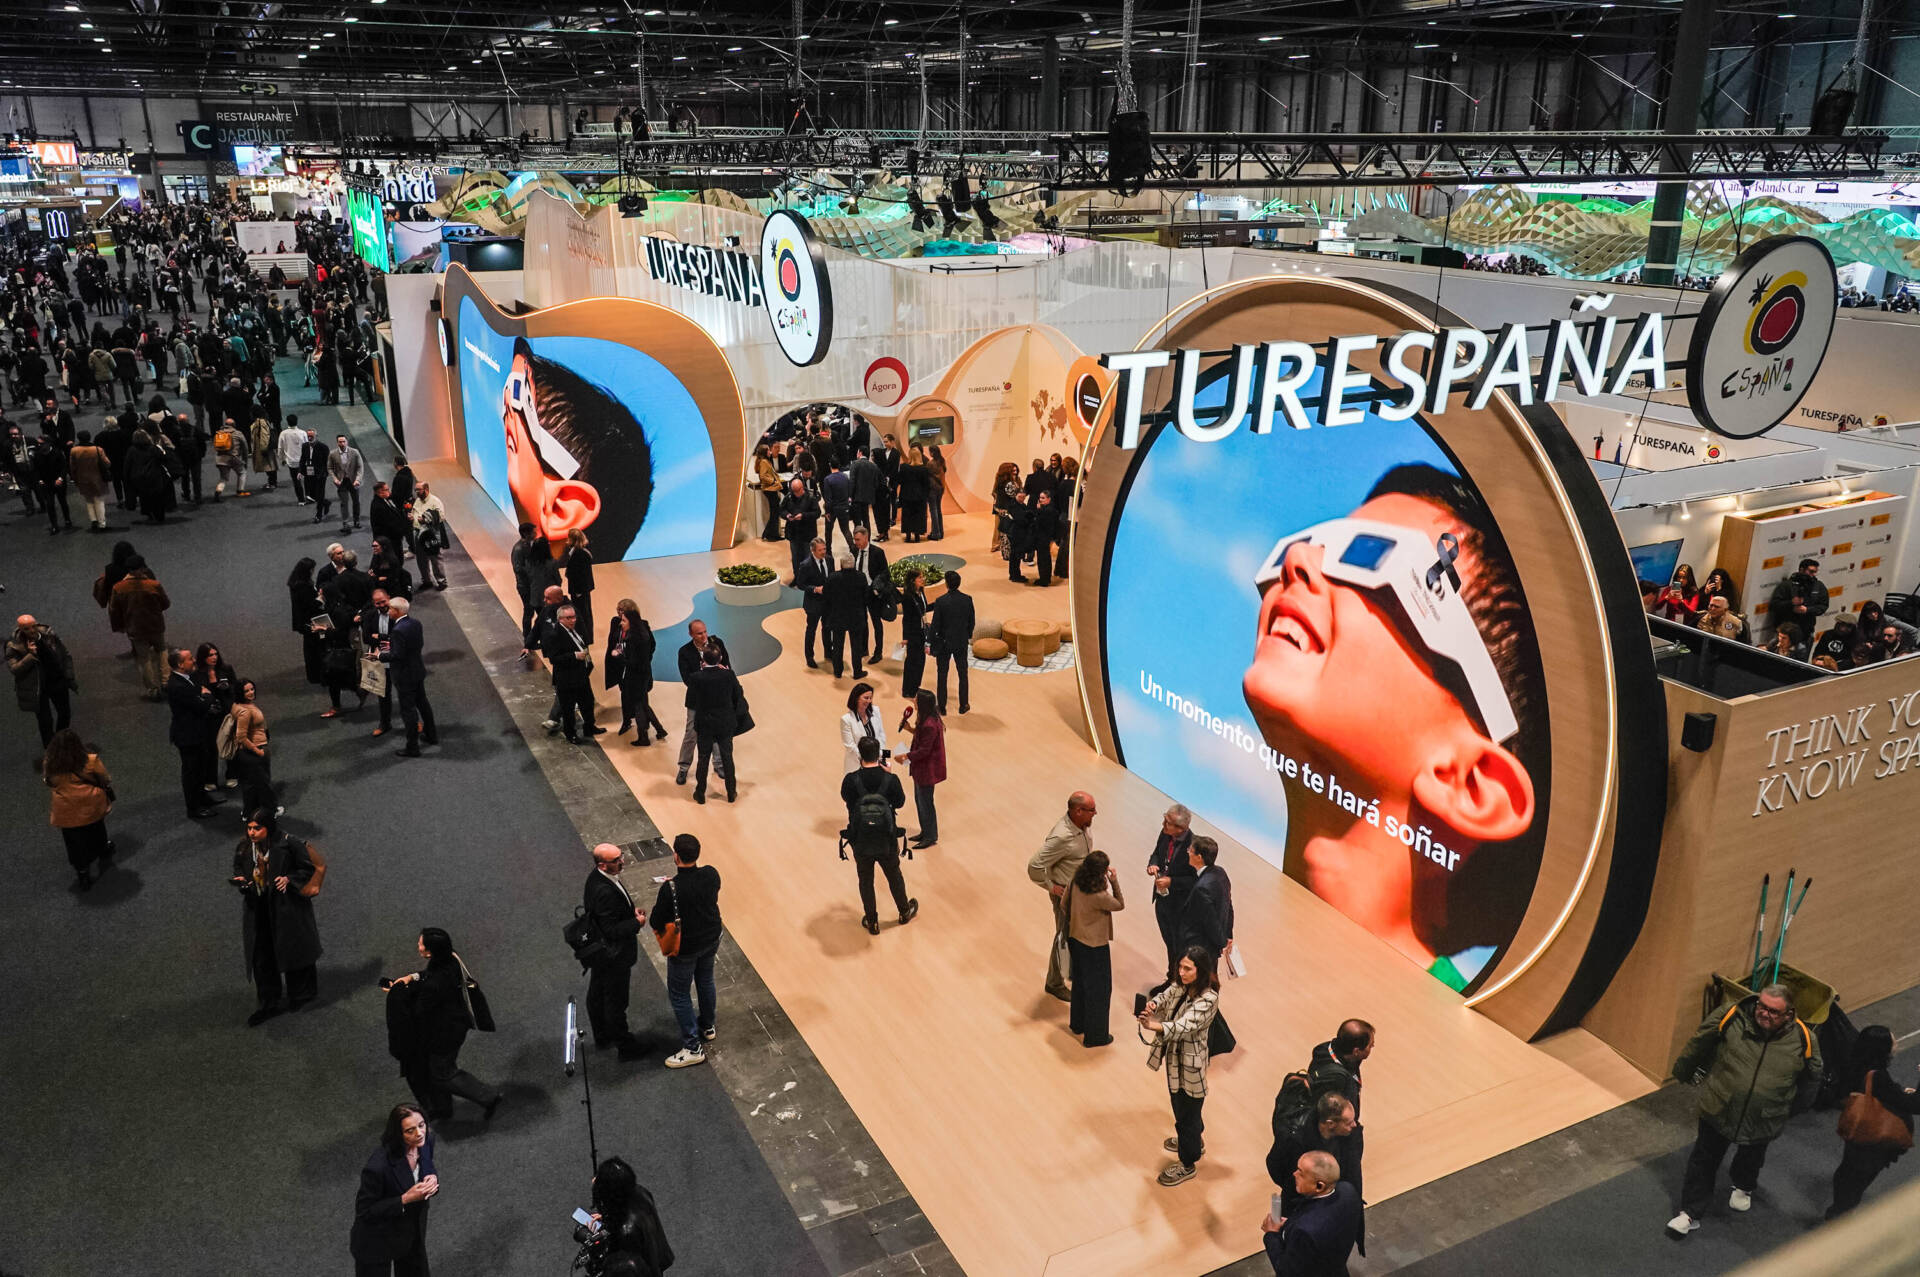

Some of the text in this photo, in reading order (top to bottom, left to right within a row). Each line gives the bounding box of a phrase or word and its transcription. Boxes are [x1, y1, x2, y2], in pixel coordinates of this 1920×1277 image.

[217, 112, 292, 122] RESTAURANTE
[191, 125, 212, 149] C
[251, 177, 295, 193] La Rioj
[1788, 182, 1806, 194] Car
[640, 235, 768, 311] TURESPAÑA
[1103, 292, 1666, 450] TURESPAÑA
[968, 384, 1000, 393] TURESPAÑA
[1800, 407, 1863, 427] TURESPAÑA
[1633, 434, 1695, 456] TURESPAÑA
[1766, 703, 1876, 768] THINK
[1140, 669, 1461, 872] Un momento que te hará soñar
[1752, 748, 1870, 818] KNOW
